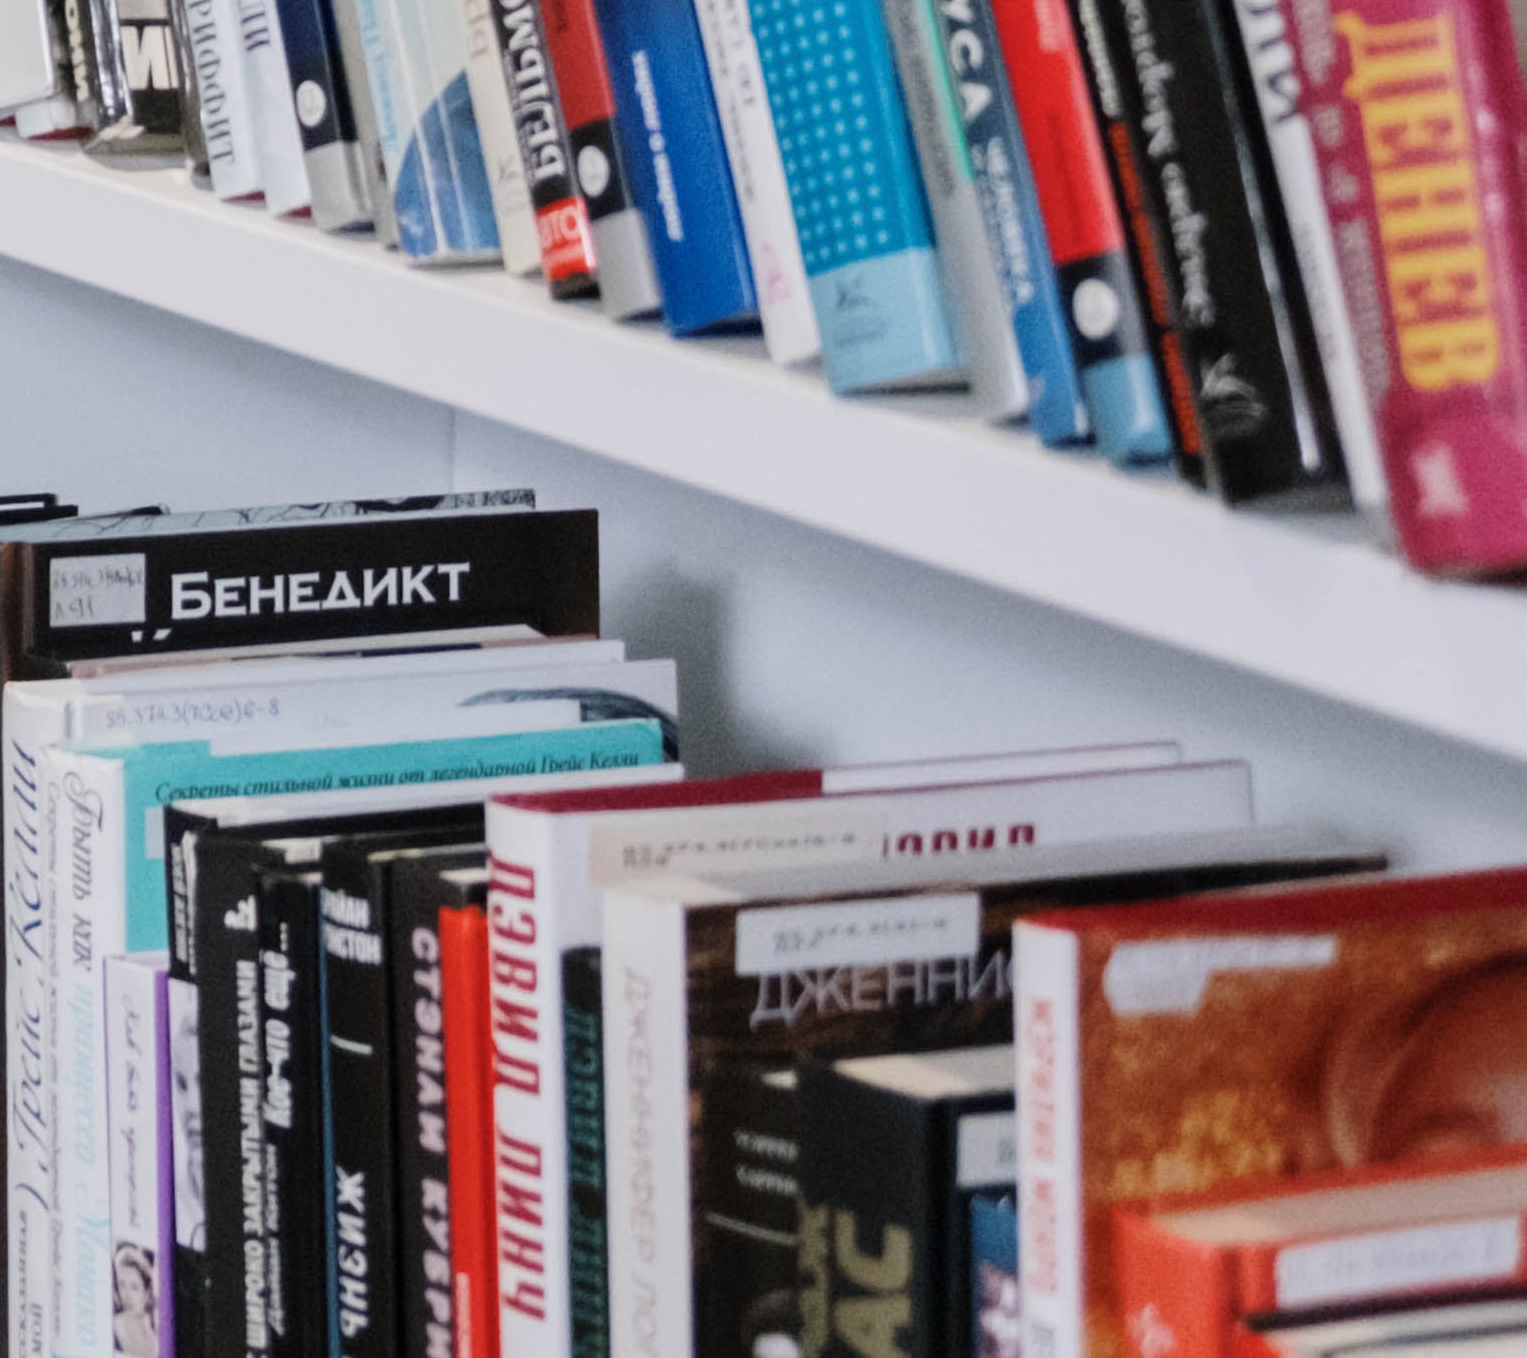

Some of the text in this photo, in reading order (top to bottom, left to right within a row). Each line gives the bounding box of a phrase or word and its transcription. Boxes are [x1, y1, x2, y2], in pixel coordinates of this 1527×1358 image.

[1338, 15, 1499, 390] ДЕНЕВ
[168, 562, 469, 620] БЕНЕДИКТ
[9, 739, 44, 959] Келли
[155, 753, 639, 804] Секреты стильной от легендарной Грейс Келли
[236, 960, 265, 1348] ШИРОКО ЗАКРЫТЫМИ ГЛАЗАМИ
[488, 854, 544, 1321] ДЭВИД ЛИНЧ
[337, 1165, 367, 1336] ЖИЗНЬ
